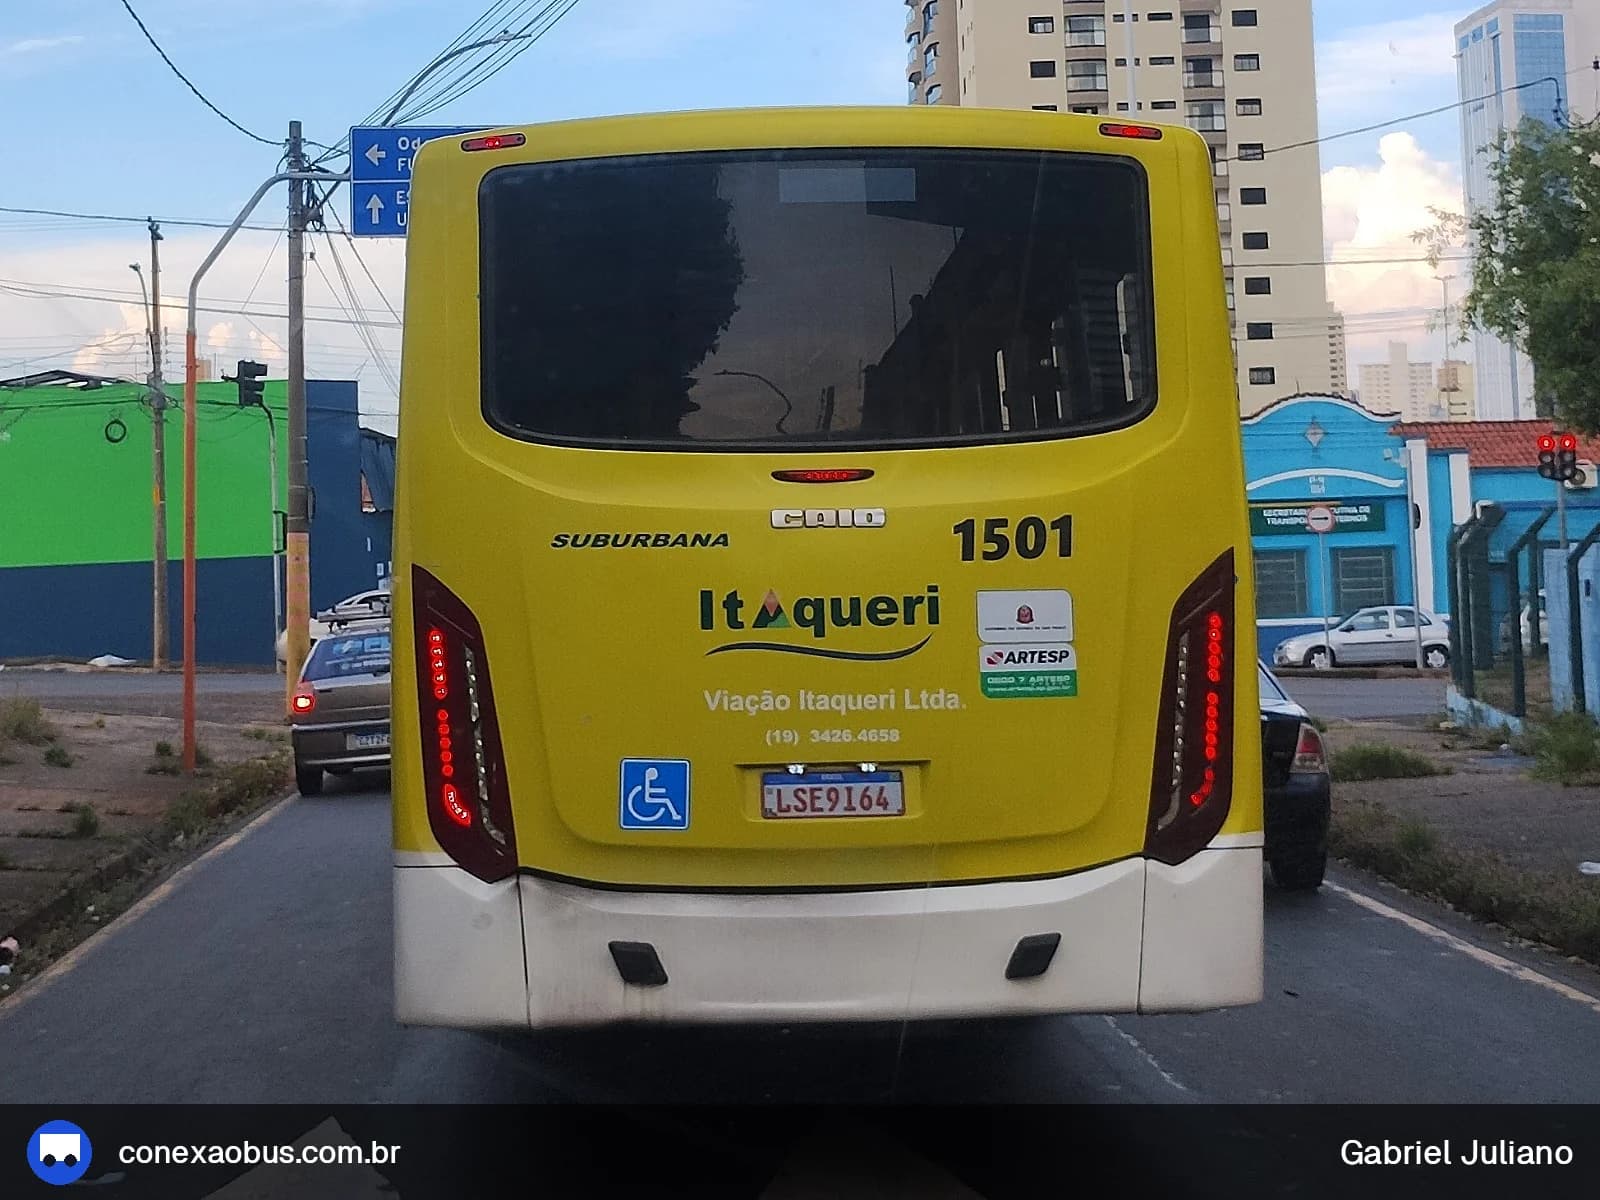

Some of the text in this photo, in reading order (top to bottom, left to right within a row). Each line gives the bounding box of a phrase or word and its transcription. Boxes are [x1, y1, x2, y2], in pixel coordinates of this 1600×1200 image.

[397, 136, 421, 151] Od
[770, 508, 886, 528] CAIO
[551, 533, 729, 548] SUBURBANA
[953, 514, 1073, 562] 1501
[1003, 650, 1070, 665] ARTESP
[703, 688, 967, 715] Viação Itaqueri Ltda.
[765, 729, 799, 746] (19)
